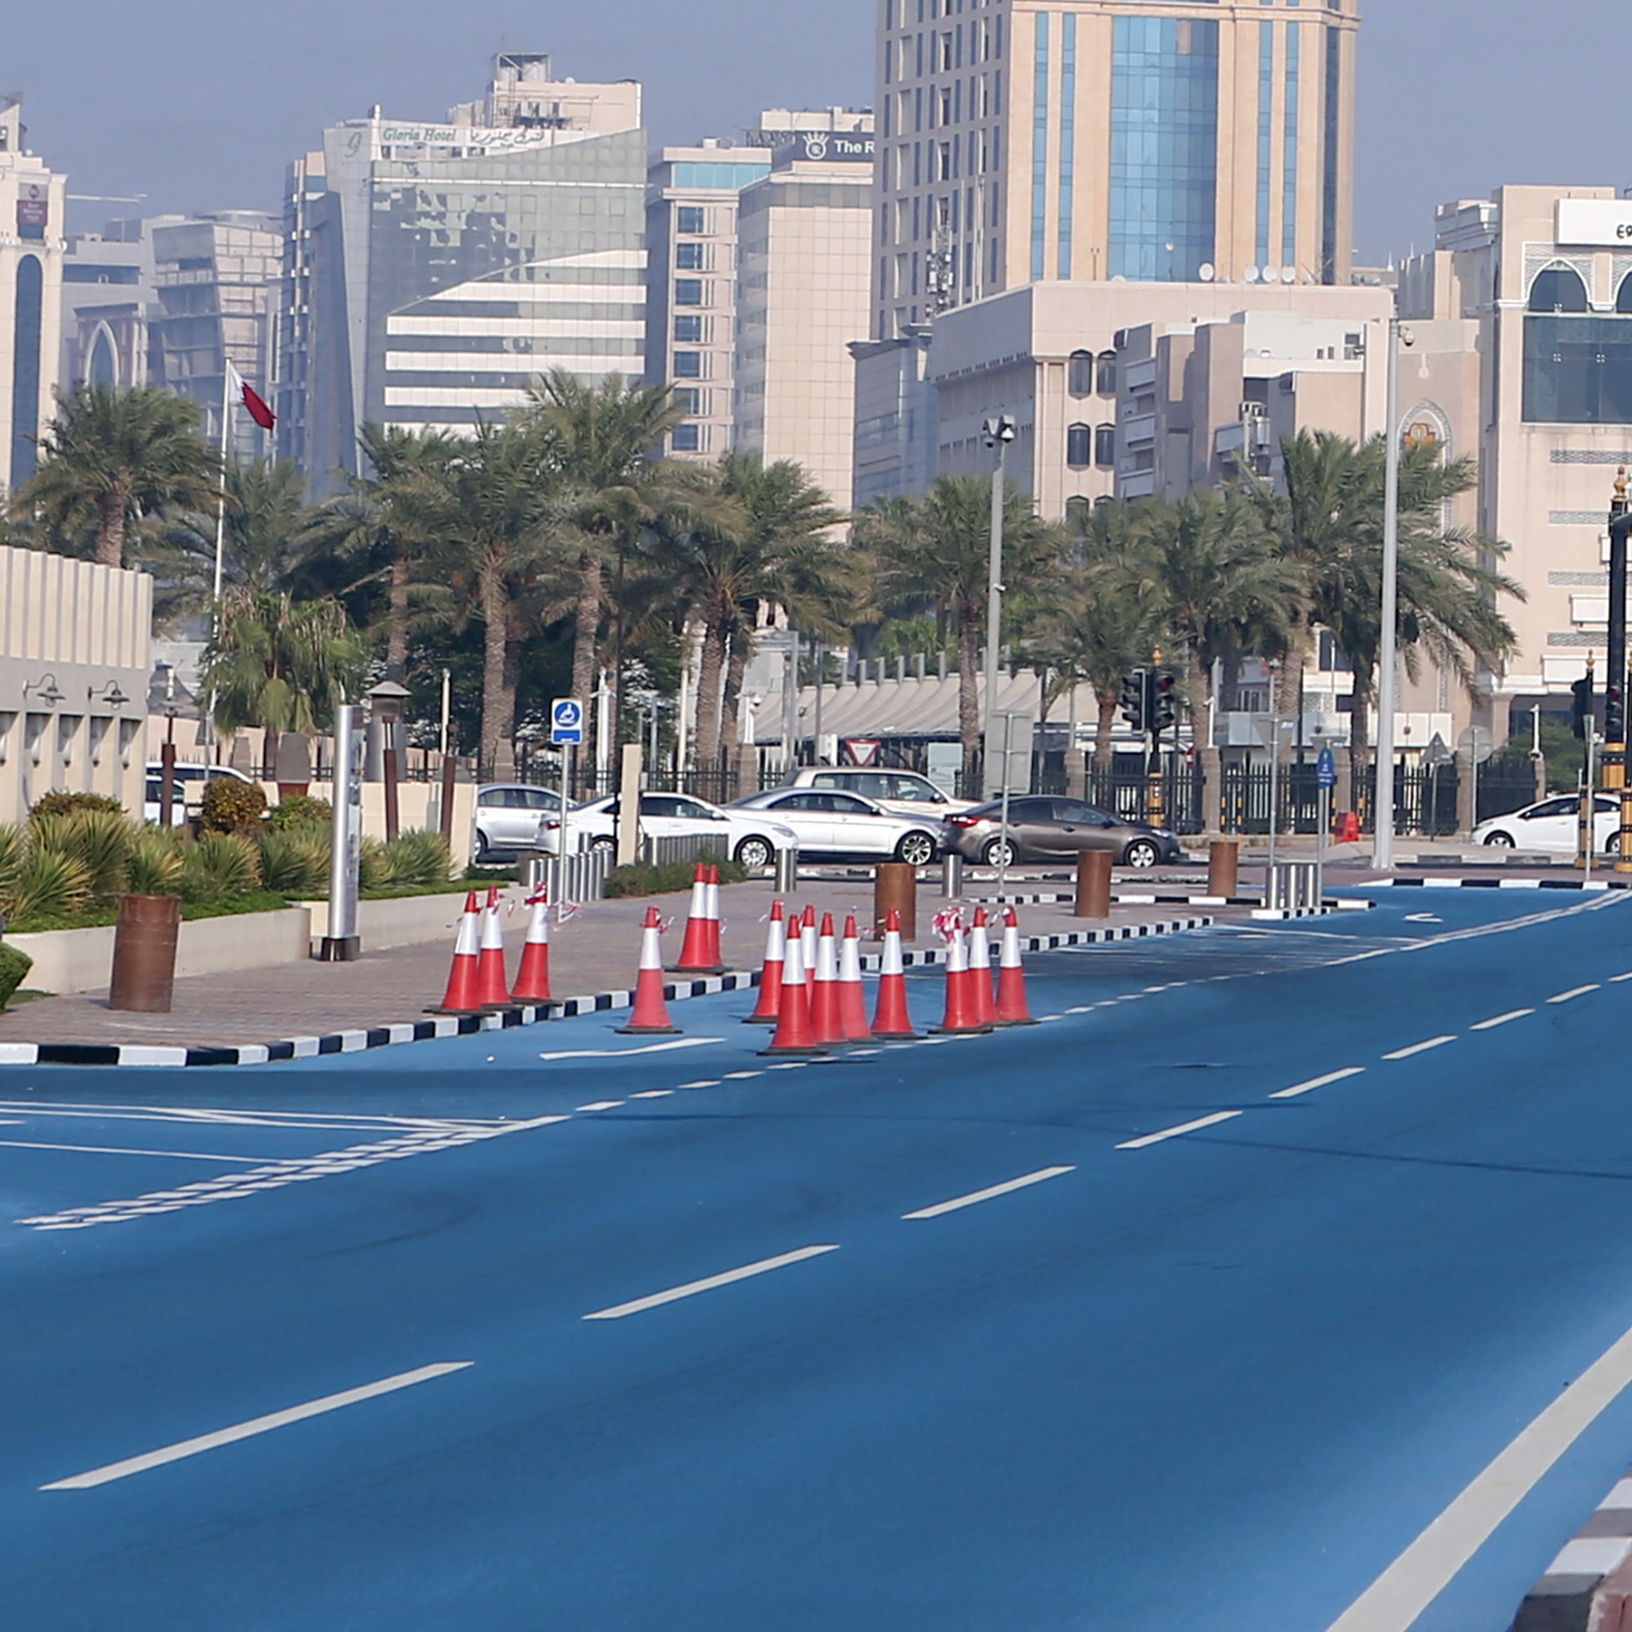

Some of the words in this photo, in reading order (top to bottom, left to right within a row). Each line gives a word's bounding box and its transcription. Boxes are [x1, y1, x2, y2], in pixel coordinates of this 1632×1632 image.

[383, 128, 420, 142] Gloria
[424, 129, 456, 142] Hotel
[833, 139, 863, 154] The
